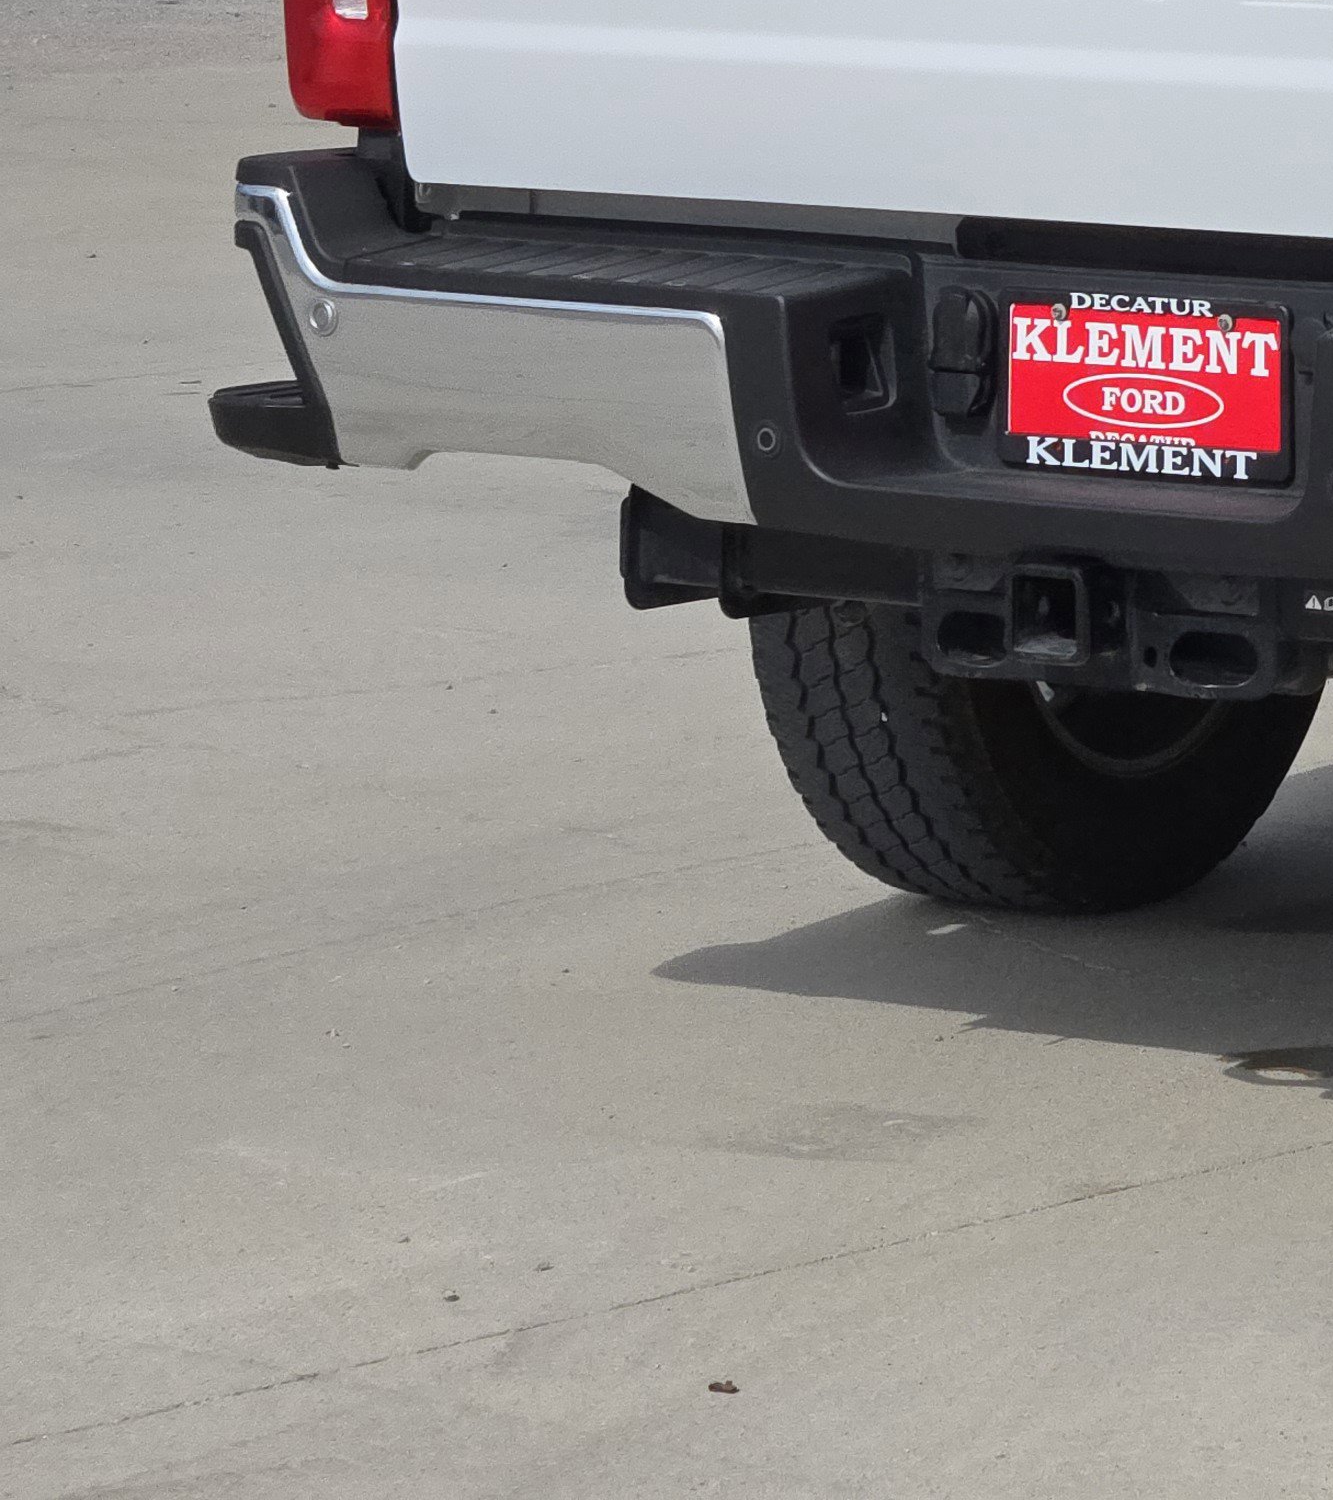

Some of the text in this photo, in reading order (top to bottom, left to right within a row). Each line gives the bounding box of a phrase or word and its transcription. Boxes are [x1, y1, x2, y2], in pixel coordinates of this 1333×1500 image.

[1068, 292, 1214, 318] DECATUR
[1011, 316, 1279, 377] KLEMENT
[1101, 386, 1186, 416] FORD
[1025, 435, 1258, 480] KLEMENT
